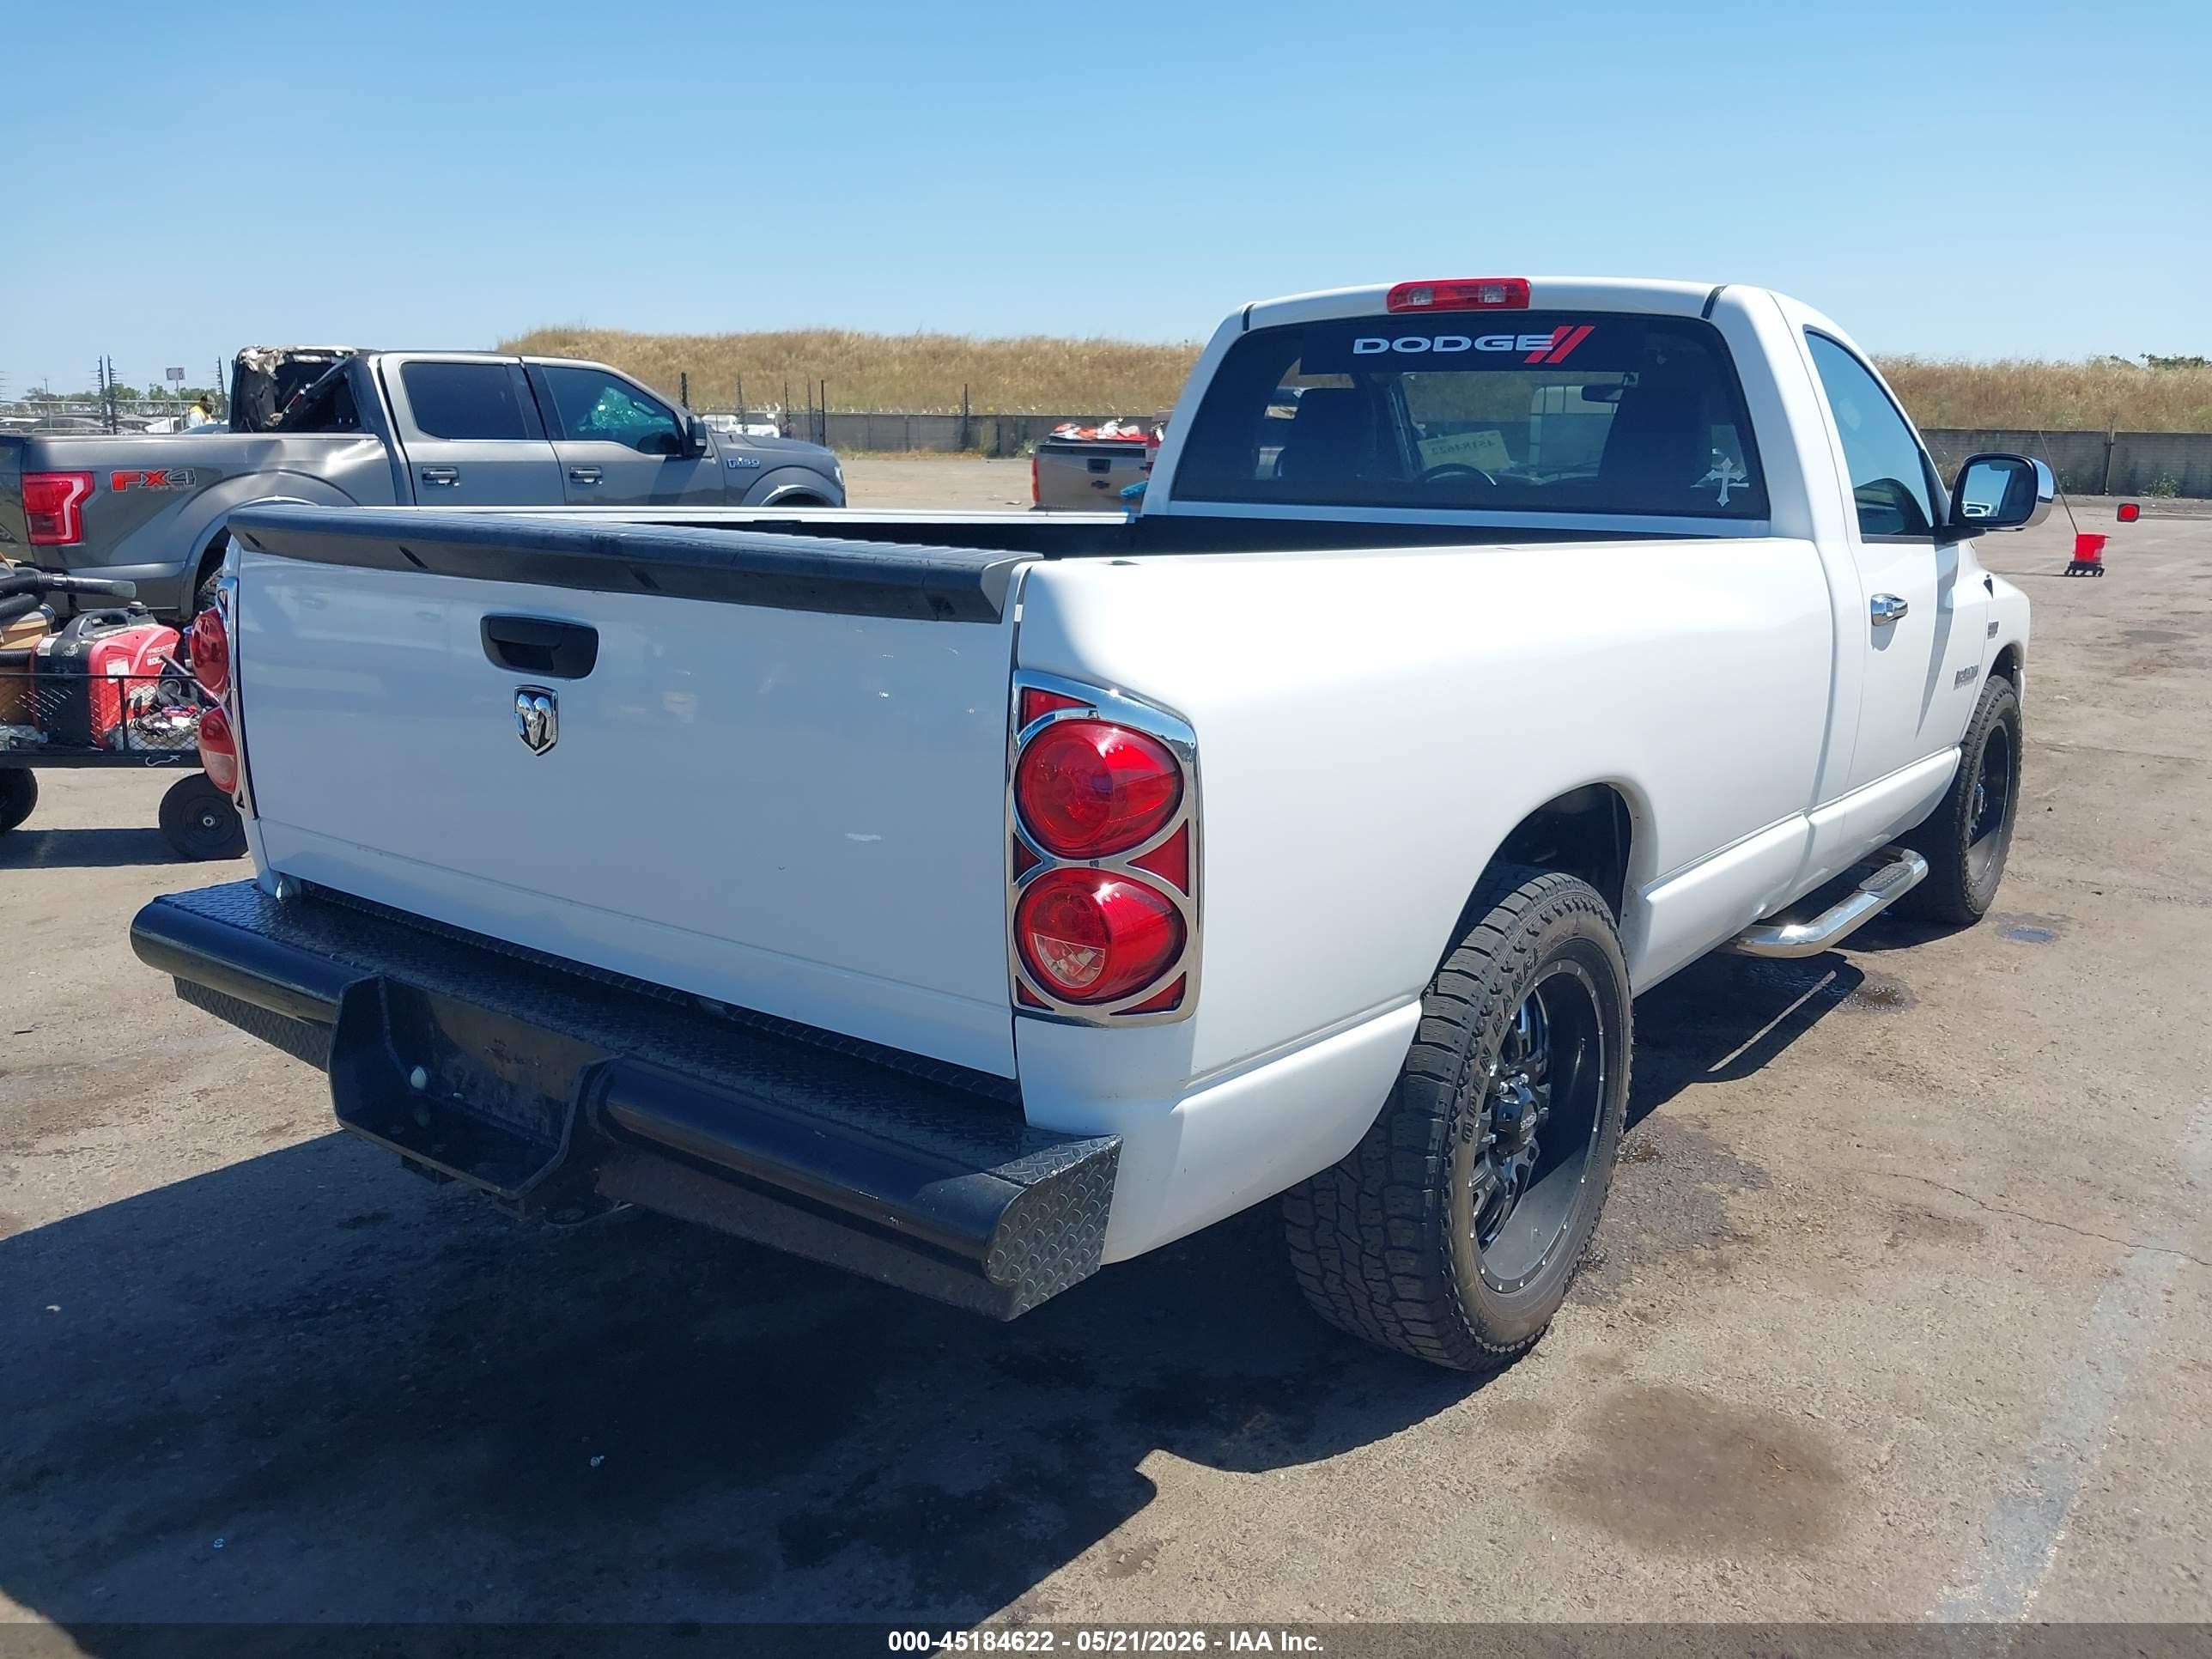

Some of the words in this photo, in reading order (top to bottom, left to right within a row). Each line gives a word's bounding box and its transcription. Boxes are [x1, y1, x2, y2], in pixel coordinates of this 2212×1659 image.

[1353, 335, 1554, 354] DODGE
[110, 469, 196, 491] FX4
[1462, 1044, 1492, 1145] OPEN
[1492, 945, 1542, 1038] RANGE
